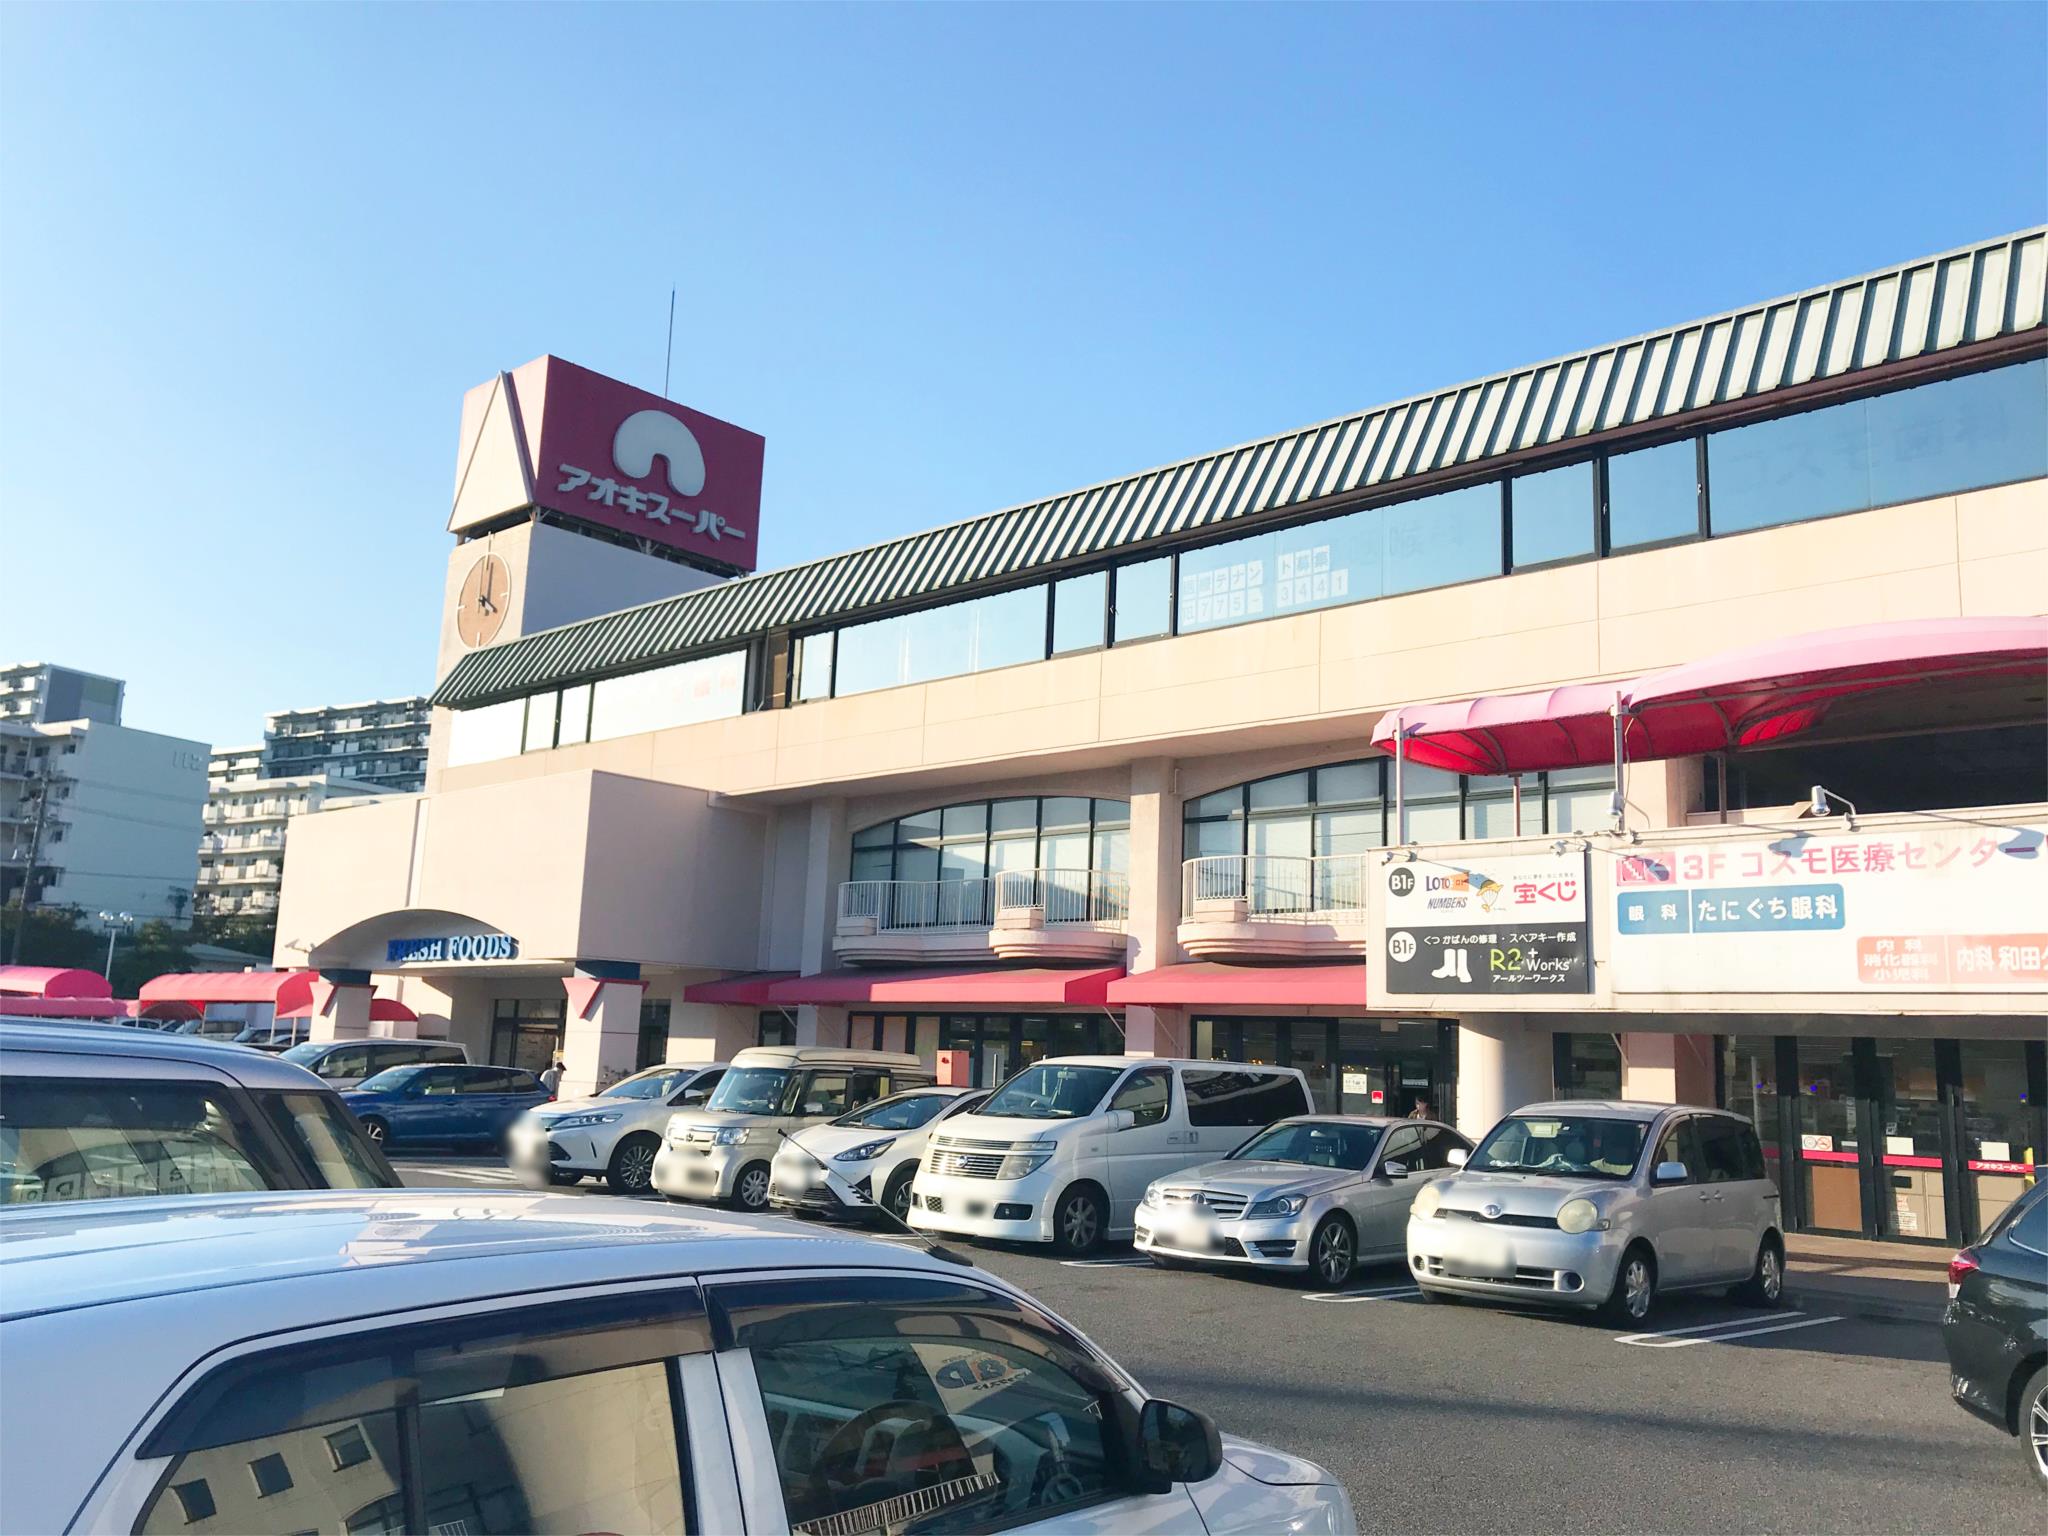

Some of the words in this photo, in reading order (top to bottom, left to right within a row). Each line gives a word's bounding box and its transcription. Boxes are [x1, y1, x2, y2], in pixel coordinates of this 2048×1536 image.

[557, 463, 746, 541] アオキスーパー
[1683, 853, 1727, 880] 3F
[1741, 837, 2036, 878] コスモ医療センター
[1391, 874, 1414, 890] B1F
[1513, 881, 1577, 905] 宝くじ
[1427, 897, 1468, 909] NUMBERS
[1698, 895, 1838, 922] たにぐち眼科
[448, 934, 515, 961] FOODS
[1392, 939, 1414, 954] B1F
[1492, 974, 1565, 983] アールツーワークス
